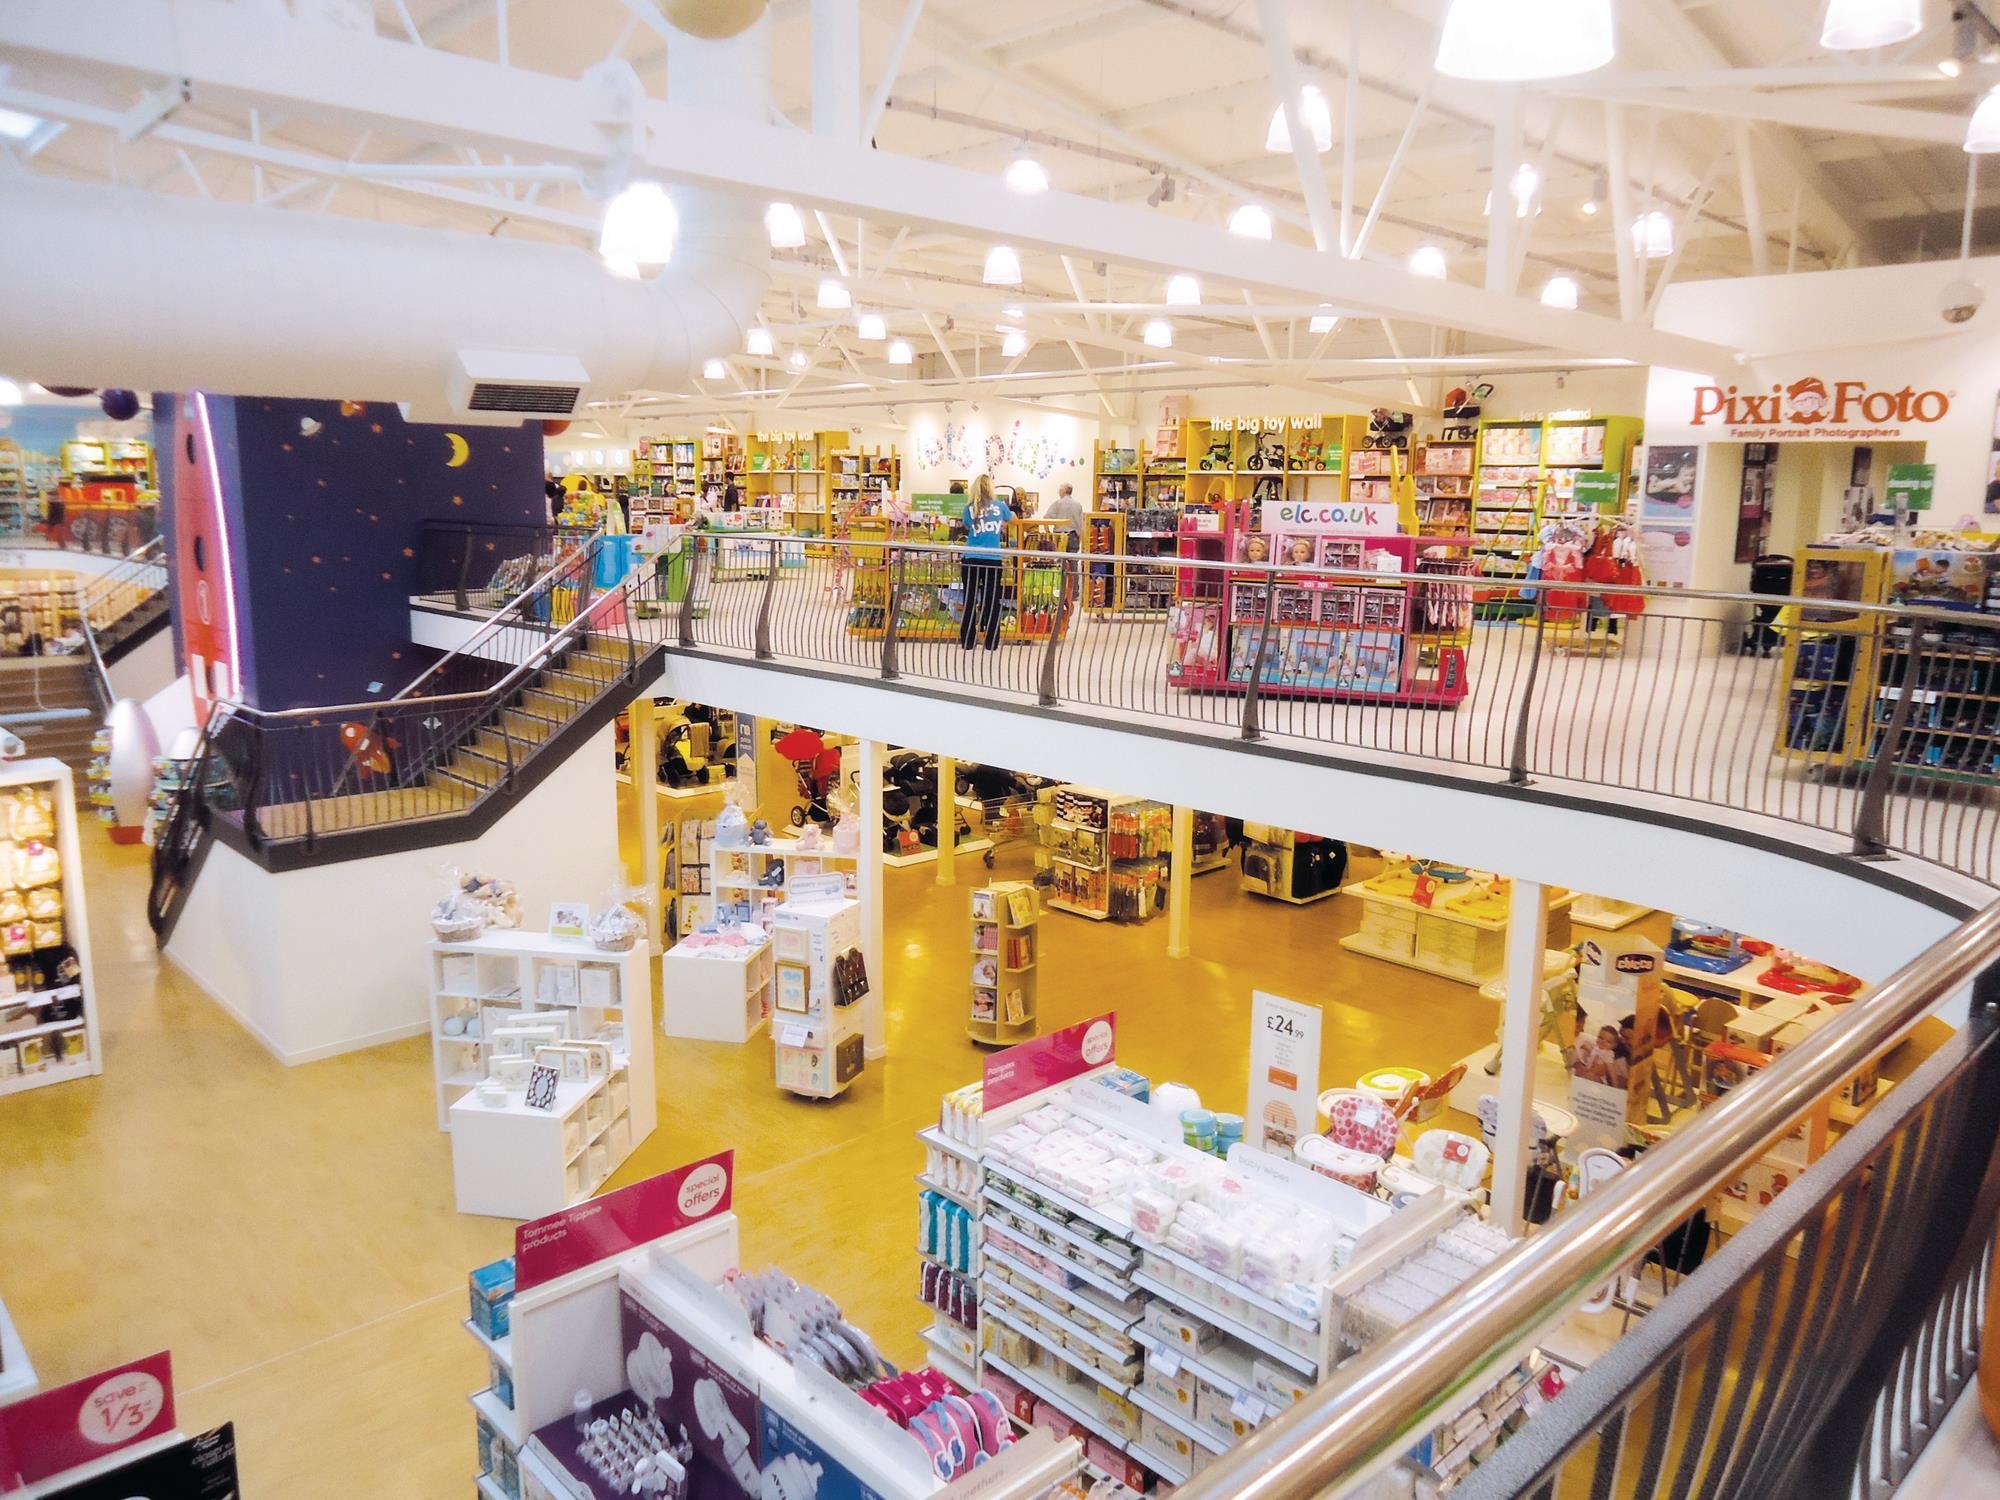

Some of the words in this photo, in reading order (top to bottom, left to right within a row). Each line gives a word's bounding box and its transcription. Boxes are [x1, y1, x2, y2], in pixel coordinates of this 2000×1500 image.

[1690, 384, 1782, 425] Pixi
[1830, 381, 1949, 424] Foto
[1210, 416, 1233, 431] the
[1237, 416, 1259, 435] big
[1262, 416, 1286, 433] toy
[1290, 412, 1322, 430] wall
[1730, 428, 1765, 439] Family
[1768, 428, 1810, 438] Portrait
[1814, 427, 1900, 439] Photographers
[757, 433, 769, 442] the
[770, 431, 783, 444] big
[784, 432, 796, 444] toy
[797, 431, 814, 441] wall
[1280, 504, 1378, 525] elc.co.uk
[686, 1174, 721, 1194] special
[684, 1186, 720, 1209] offers
[523, 1218, 566, 1240] Tommee
[522, 1229, 567, 1252] products
[94, 1386, 136, 1408] save
[101, 1402, 143, 1432] 1/3
